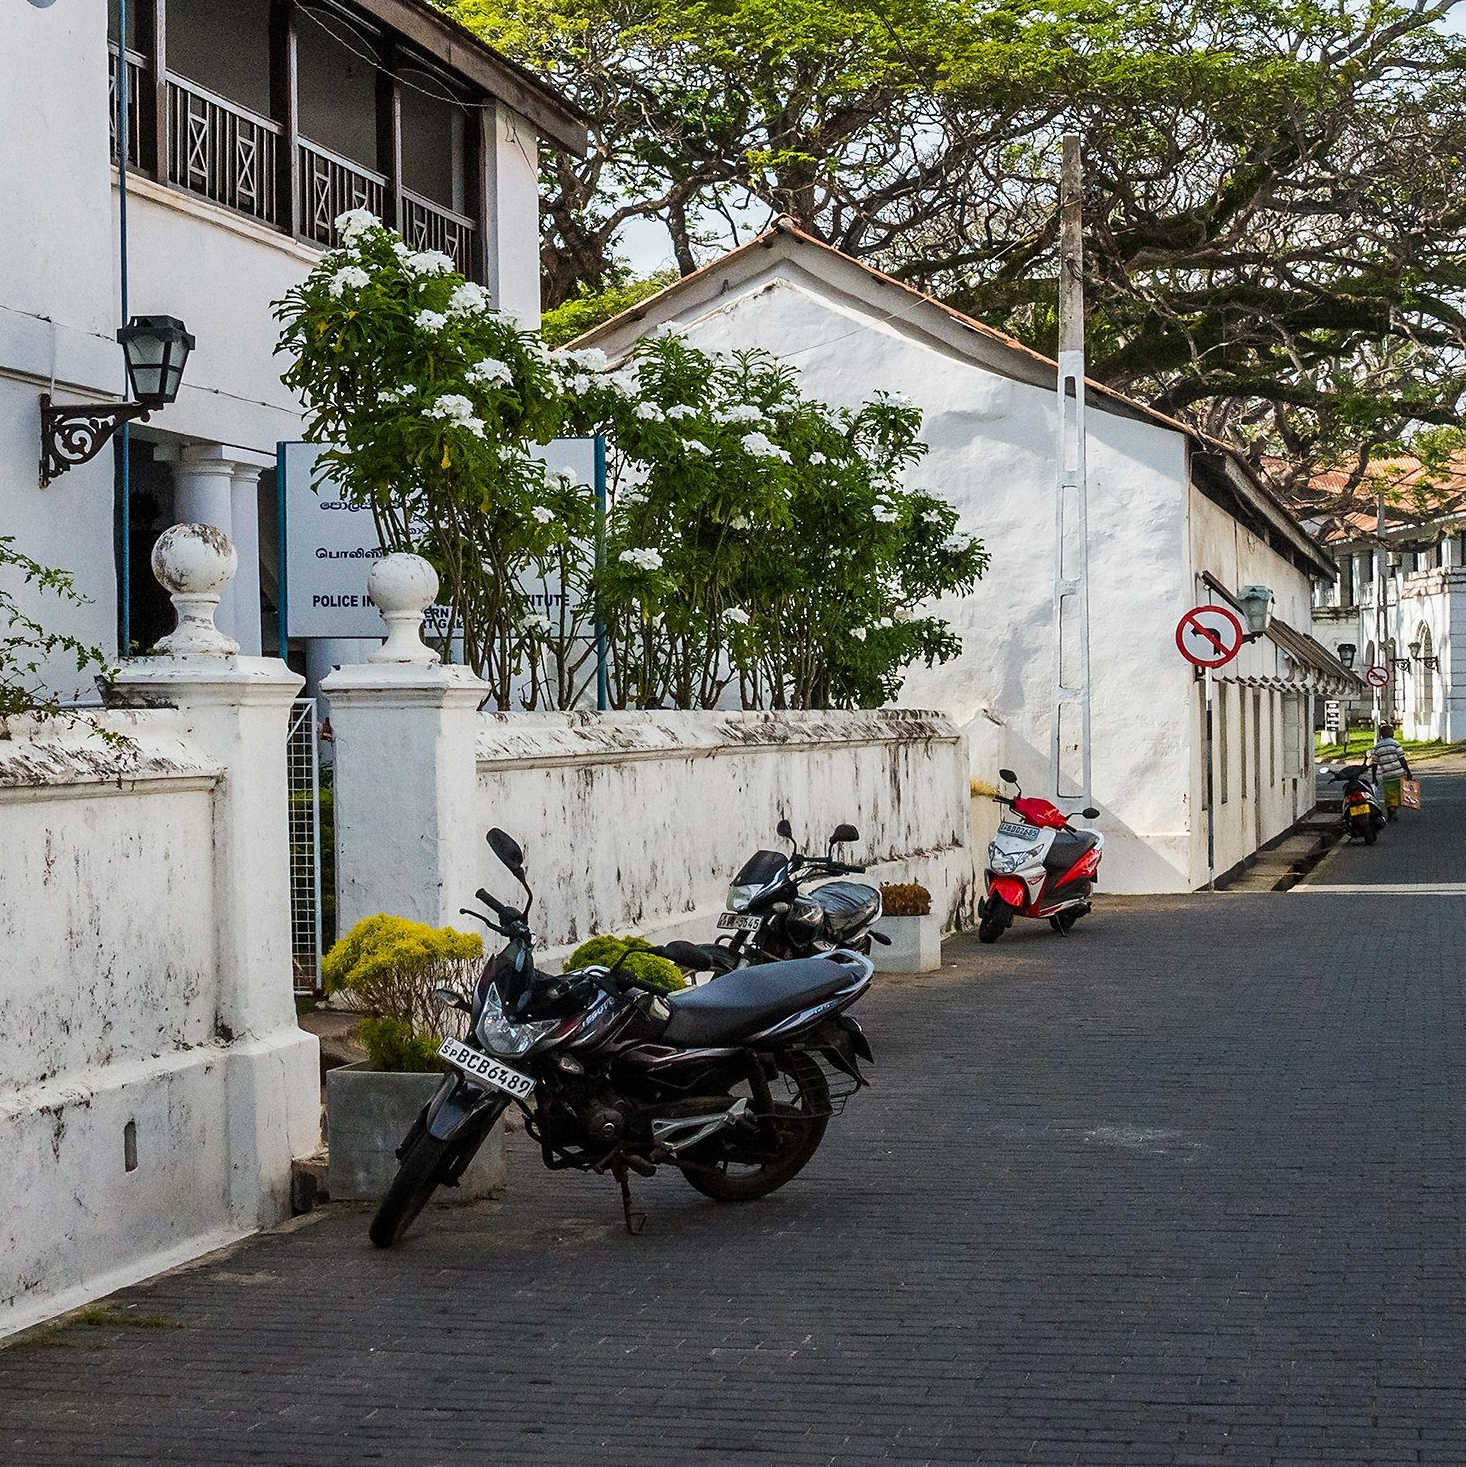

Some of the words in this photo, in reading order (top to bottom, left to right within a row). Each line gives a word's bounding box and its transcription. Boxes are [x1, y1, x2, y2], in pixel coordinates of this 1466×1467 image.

[312, 594, 358, 608] POLICE
[441, 1044, 458, 1057] SP
[455, 1048, 531, 1094] BCB6489
